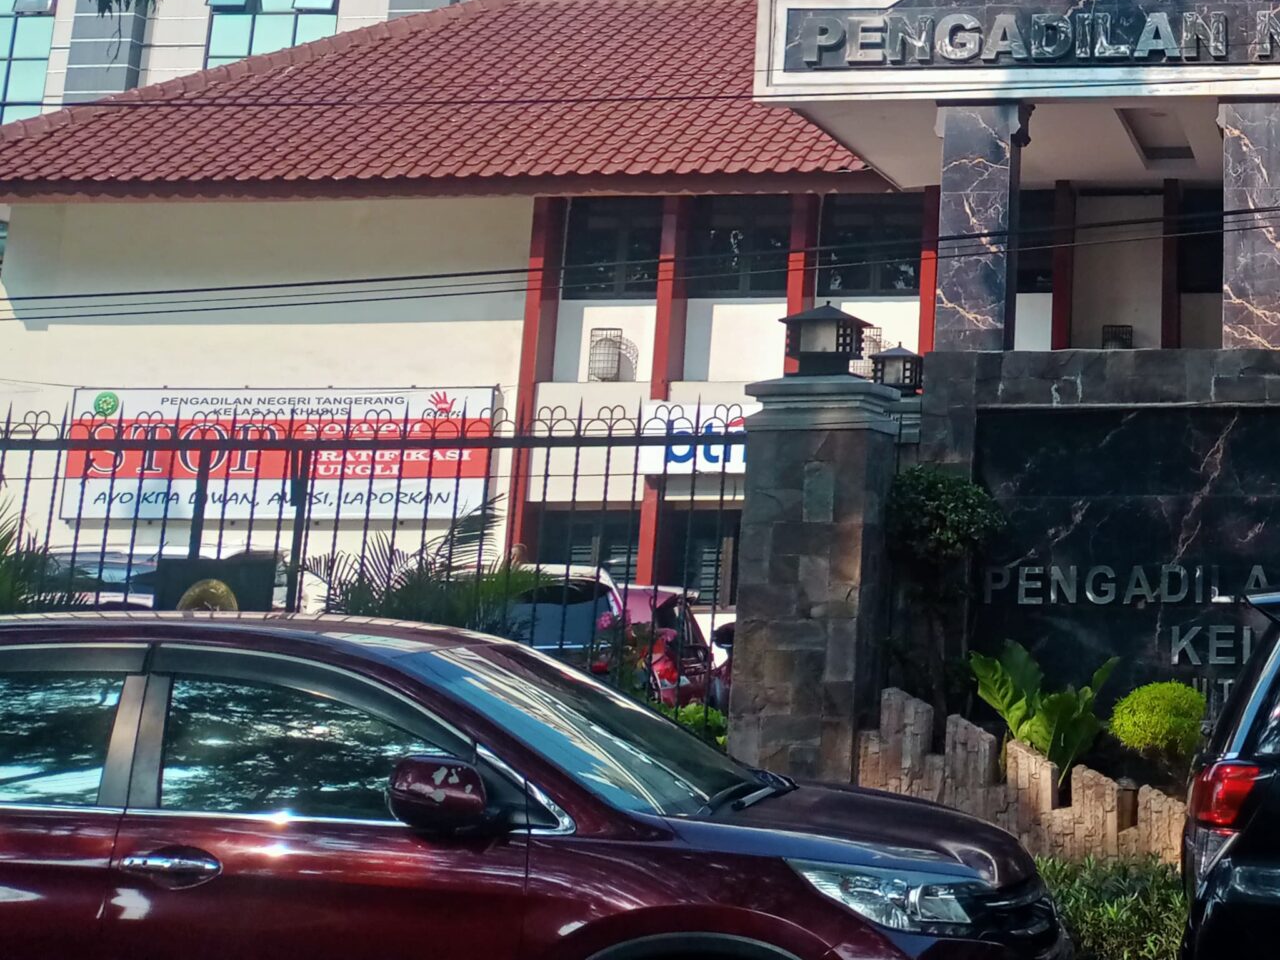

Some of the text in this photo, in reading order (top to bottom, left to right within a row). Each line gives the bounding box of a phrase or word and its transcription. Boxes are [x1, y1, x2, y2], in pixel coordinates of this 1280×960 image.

[802, 11, 1229, 67] PENGADILAN
[160, 395, 405, 406] PENGADILAN NEGERI TANGERANG
[213, 407, 260, 416] KELAS
[87, 422, 279, 474] STOP
[310, 449, 473, 462] RATIFIKASI
[309, 464, 400, 476] UNGLI
[94, 491, 135, 505] AYO
[188, 491, 259, 507] LWAN,
